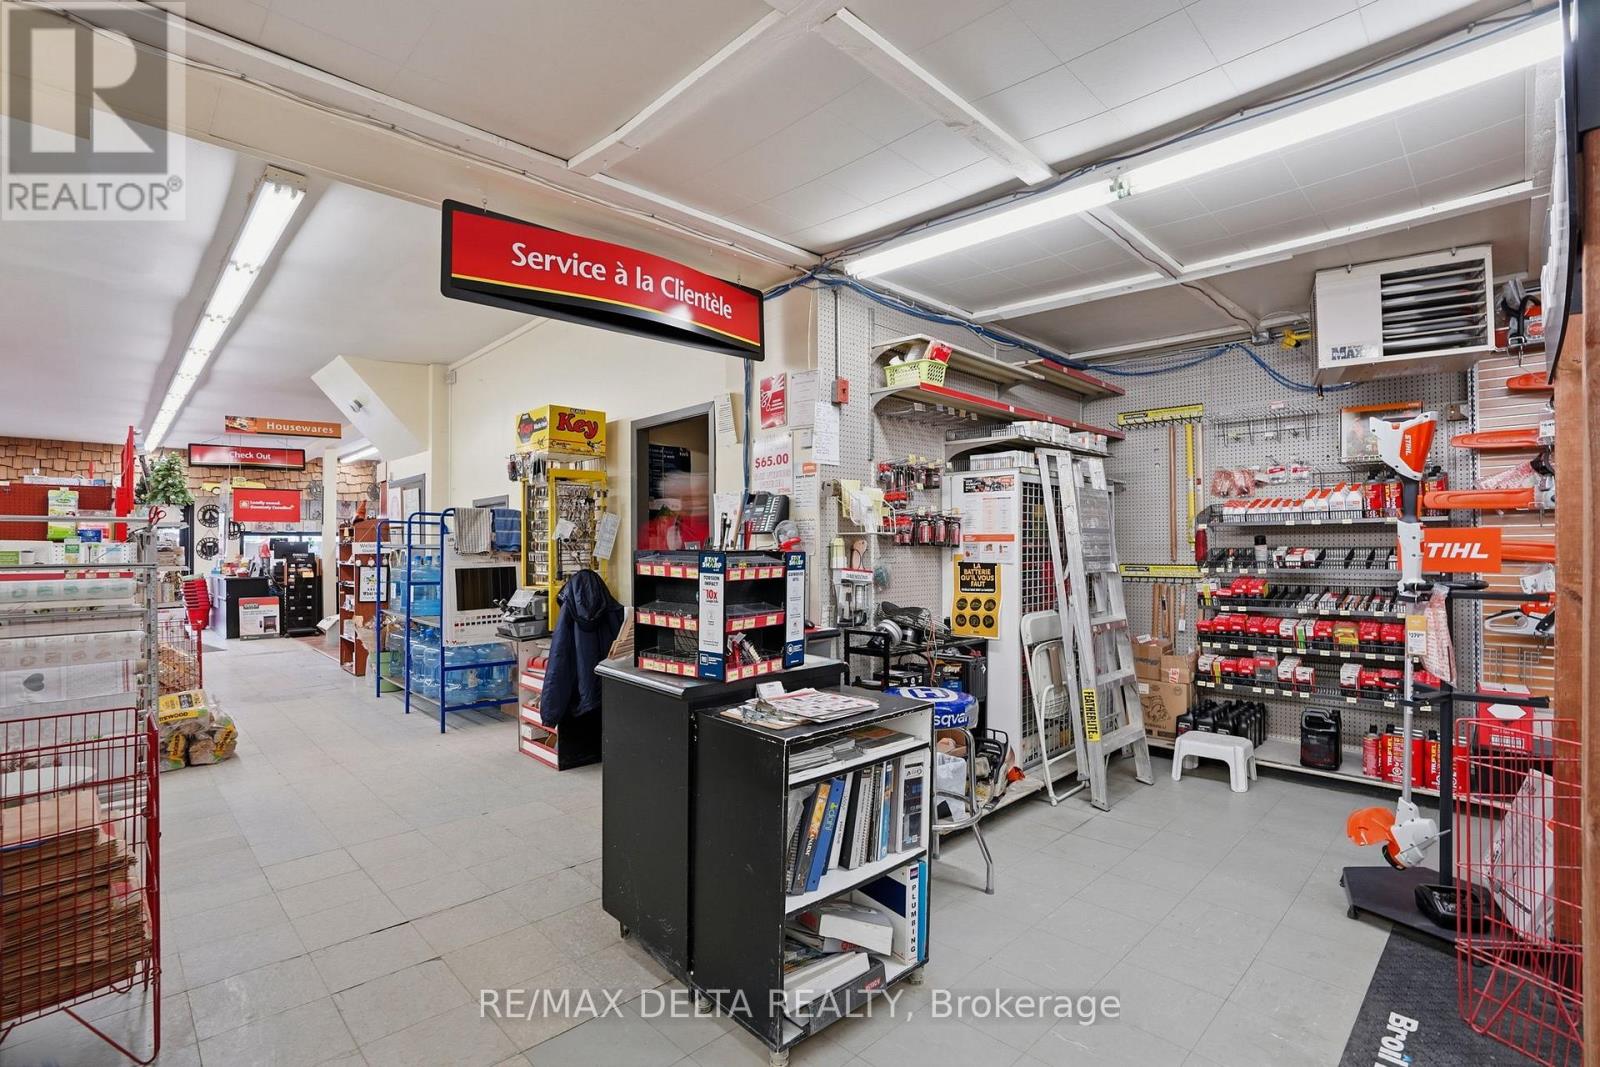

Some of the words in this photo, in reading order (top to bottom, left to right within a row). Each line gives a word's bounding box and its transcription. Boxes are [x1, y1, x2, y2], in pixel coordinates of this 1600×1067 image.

[511, 242, 606, 281] Service
[614, 261, 628, 286] à
[636, 267, 654, 293] la
[660, 276, 733, 319] Clientèle
[266, 422, 334, 434] Housewares
[556, 412, 599, 439] Key
[229, 451, 254, 459] Check
[256, 452, 271, 460] Out
[1404, 434, 1412, 456] STIHL
[755, 453, 789, 469] $65.00
[1424, 542, 1489, 559] TIHL
[1083, 691, 1099, 735] FEATHERLITE
[1378, 1011, 1419, 1067] Broil
